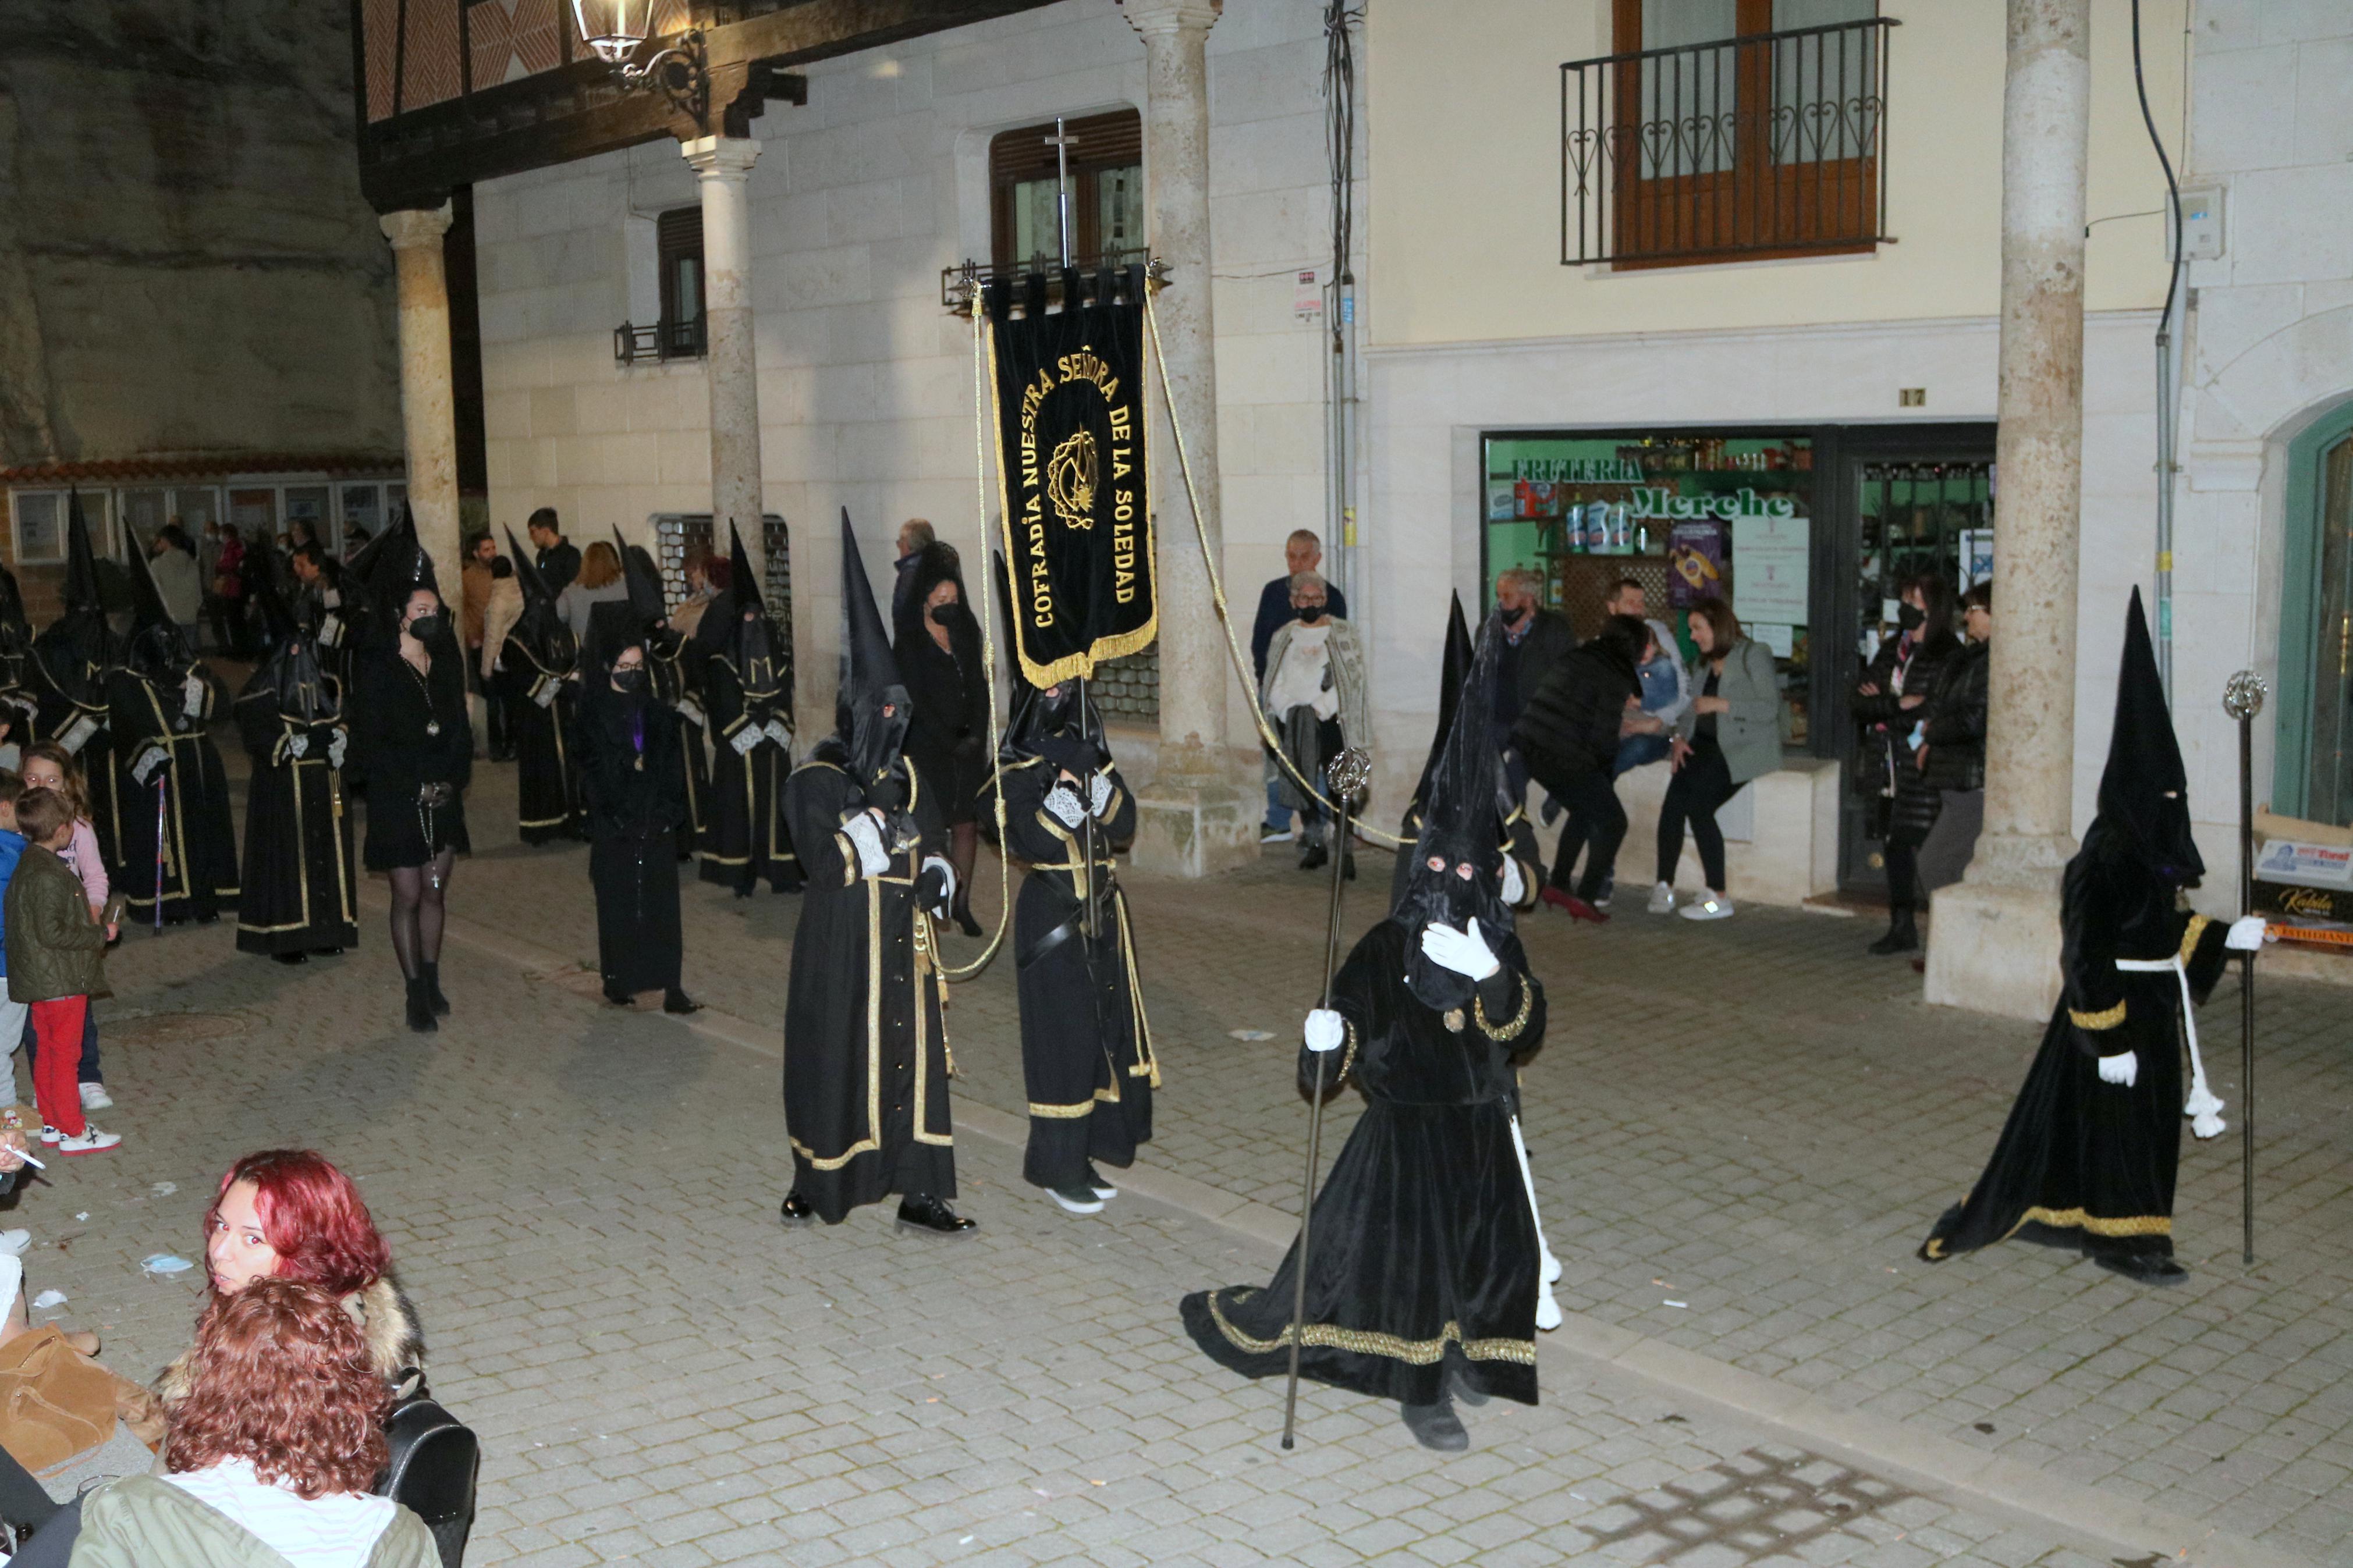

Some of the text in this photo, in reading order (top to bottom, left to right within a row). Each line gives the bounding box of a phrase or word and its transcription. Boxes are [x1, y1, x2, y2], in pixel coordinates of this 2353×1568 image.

[1021, 346, 1134, 628] COFRADÍA NUESTRA SEÑORA DE LA SOLEDAD
[1513, 458, 1645, 484] FRUTERIA
[1631, 487, 1795, 520] Merche
